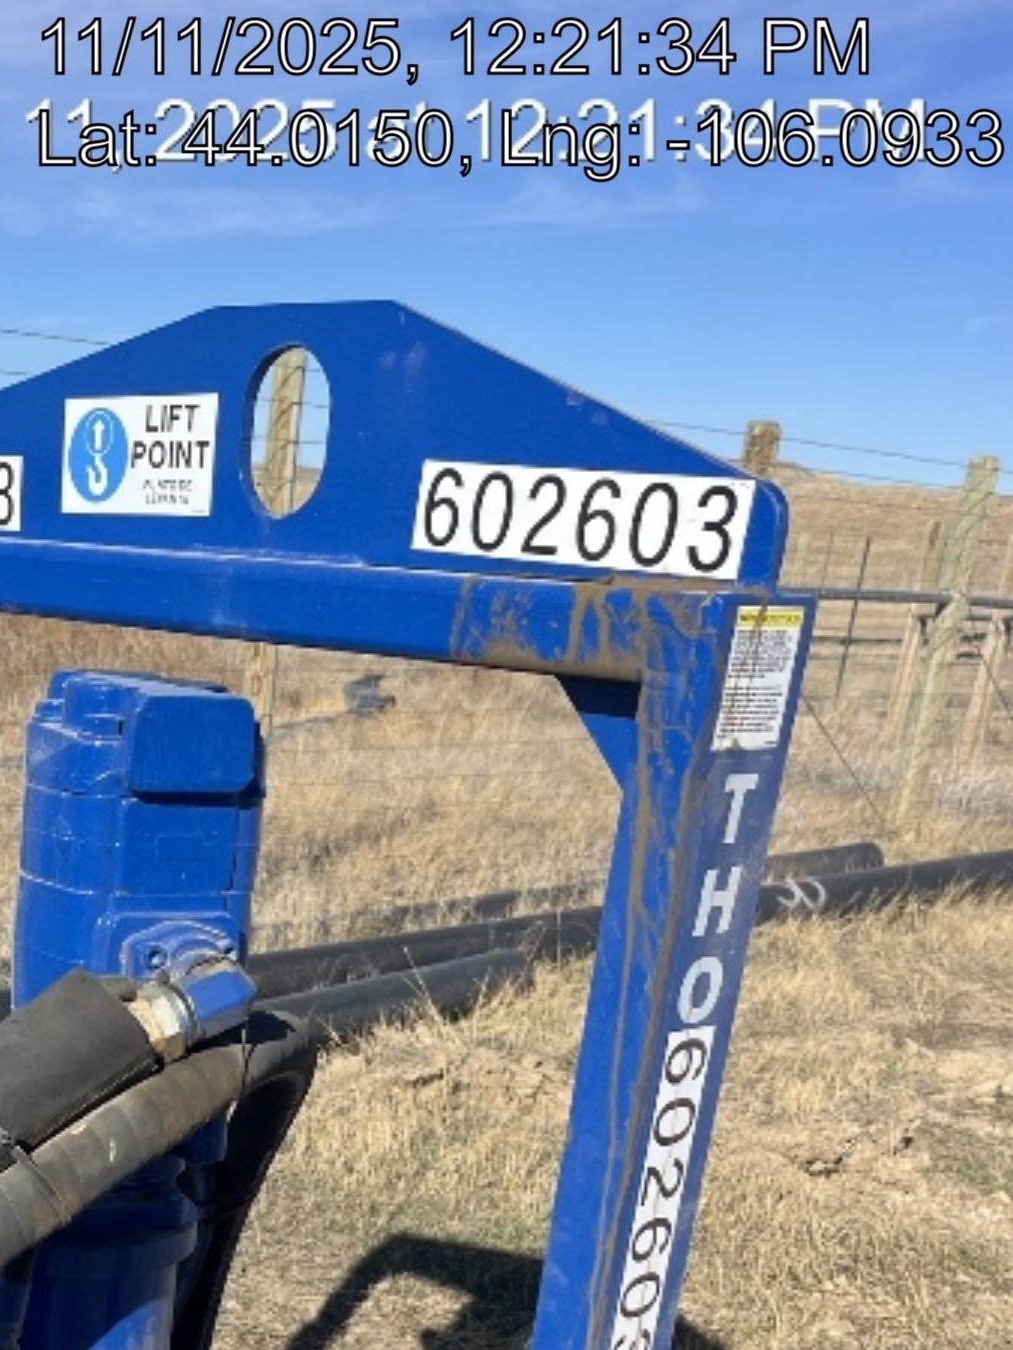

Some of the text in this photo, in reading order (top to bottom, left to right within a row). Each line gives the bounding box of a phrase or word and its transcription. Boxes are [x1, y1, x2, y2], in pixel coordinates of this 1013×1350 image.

[145, 404, 201, 433] LIFT
[130, 440, 210, 469] POINT
[425, 467, 738, 572] 602603
